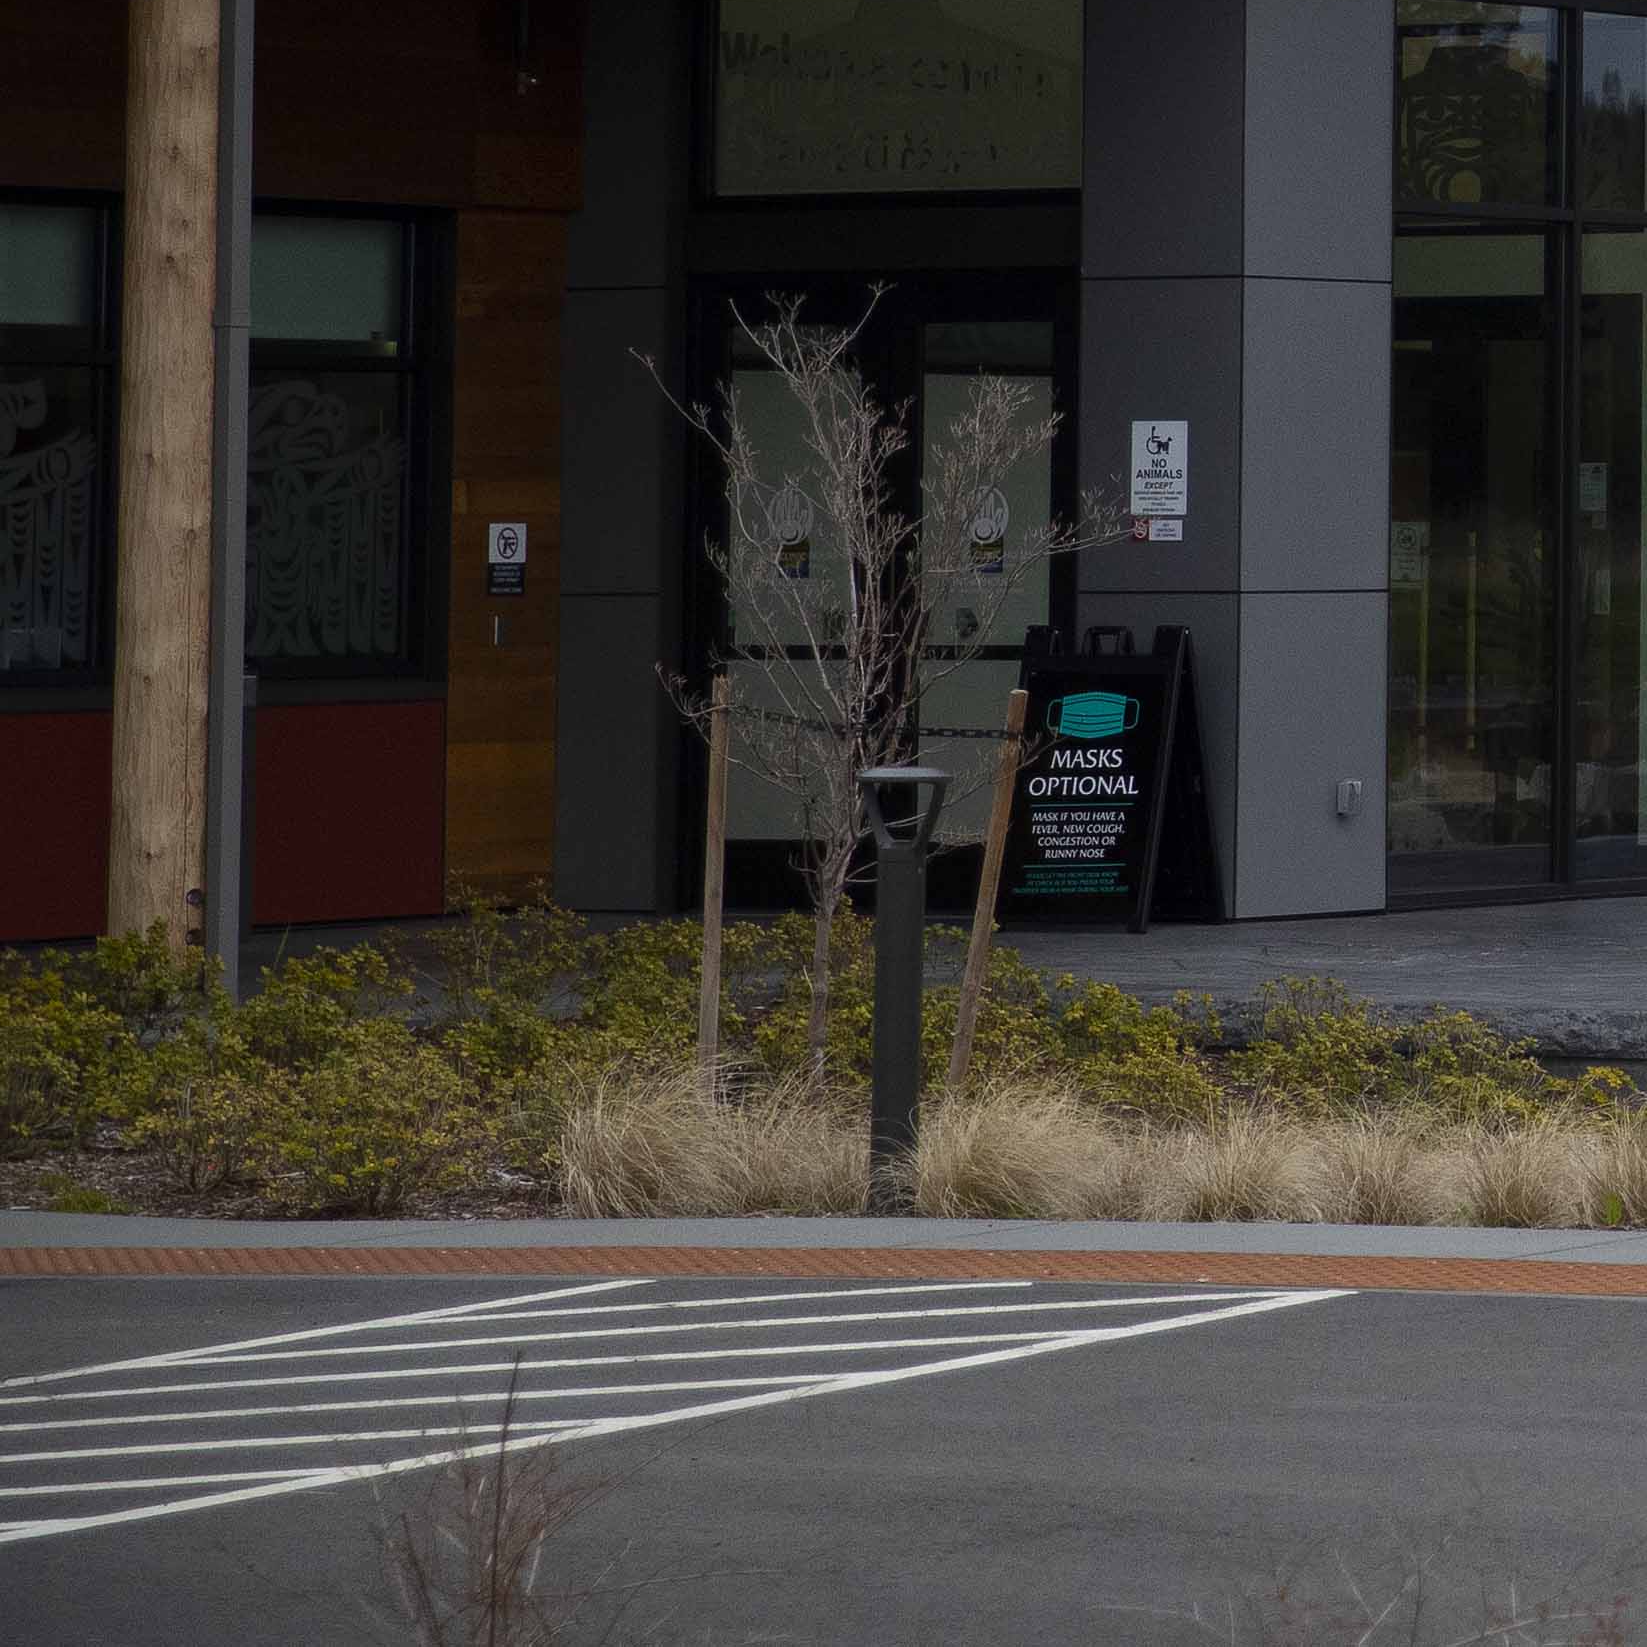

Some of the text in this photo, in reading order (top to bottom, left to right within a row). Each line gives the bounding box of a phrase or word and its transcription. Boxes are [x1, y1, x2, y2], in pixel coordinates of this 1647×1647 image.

[1151, 458, 1167, 469] NO
[1136, 469, 1183, 479] ANIMALS
[1144, 481, 1174, 490] EXCEPT
[1050, 748, 1123, 769] MASKS
[1028, 775, 1140, 796] OPTIONAL
[1032, 811, 1126, 822] MASK IF YOU HAVE A
[1032, 824, 1126, 834] FEVER, NEW COUGH,
[1037, 836, 1116, 847] CONGESTION OR
[1044, 848, 1105, 859] RUNNY NOSE
